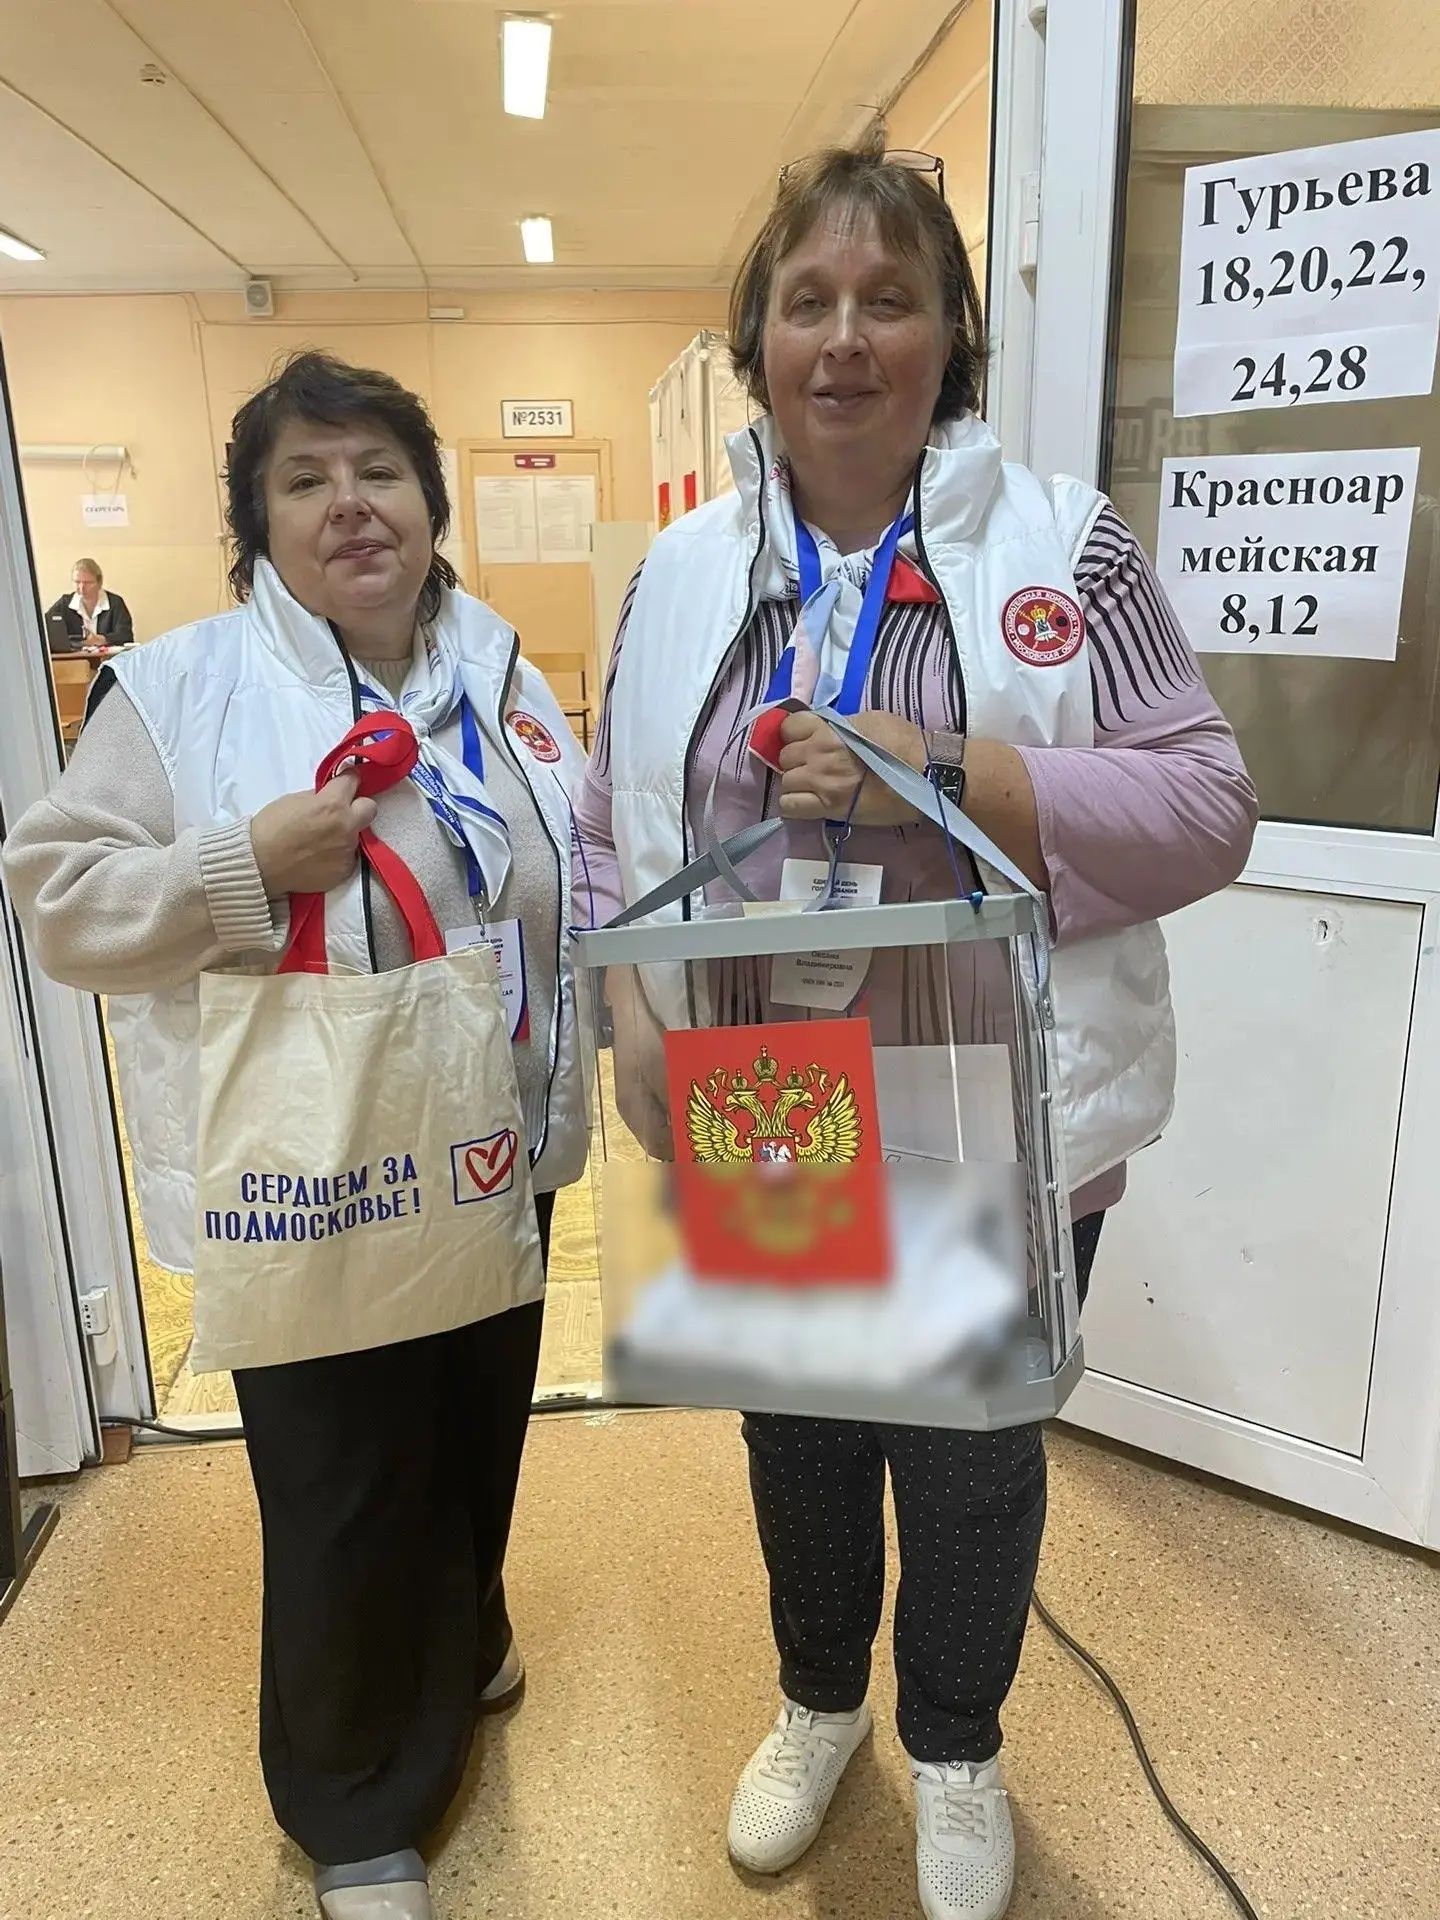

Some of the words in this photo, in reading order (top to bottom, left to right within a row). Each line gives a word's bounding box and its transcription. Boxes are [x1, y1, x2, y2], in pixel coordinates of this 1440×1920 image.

[1198, 160, 1432, 234] Гурьева
[1195, 236, 1425, 309] 18,20,22,
[1230, 345, 1368, 405] 24,28
[512, 411, 562, 425] №2531
[1168, 469, 1404, 518] Красноар
[1179, 536, 1379, 573] мейская
[1219, 593, 1320, 643] 8,12
[241, 1165, 368, 1208] СЕРДЦЕМ
[383, 1154, 418, 1185] ЗА
[205, 1187, 421, 1243] ПОДМОСКОВЬЕ!
